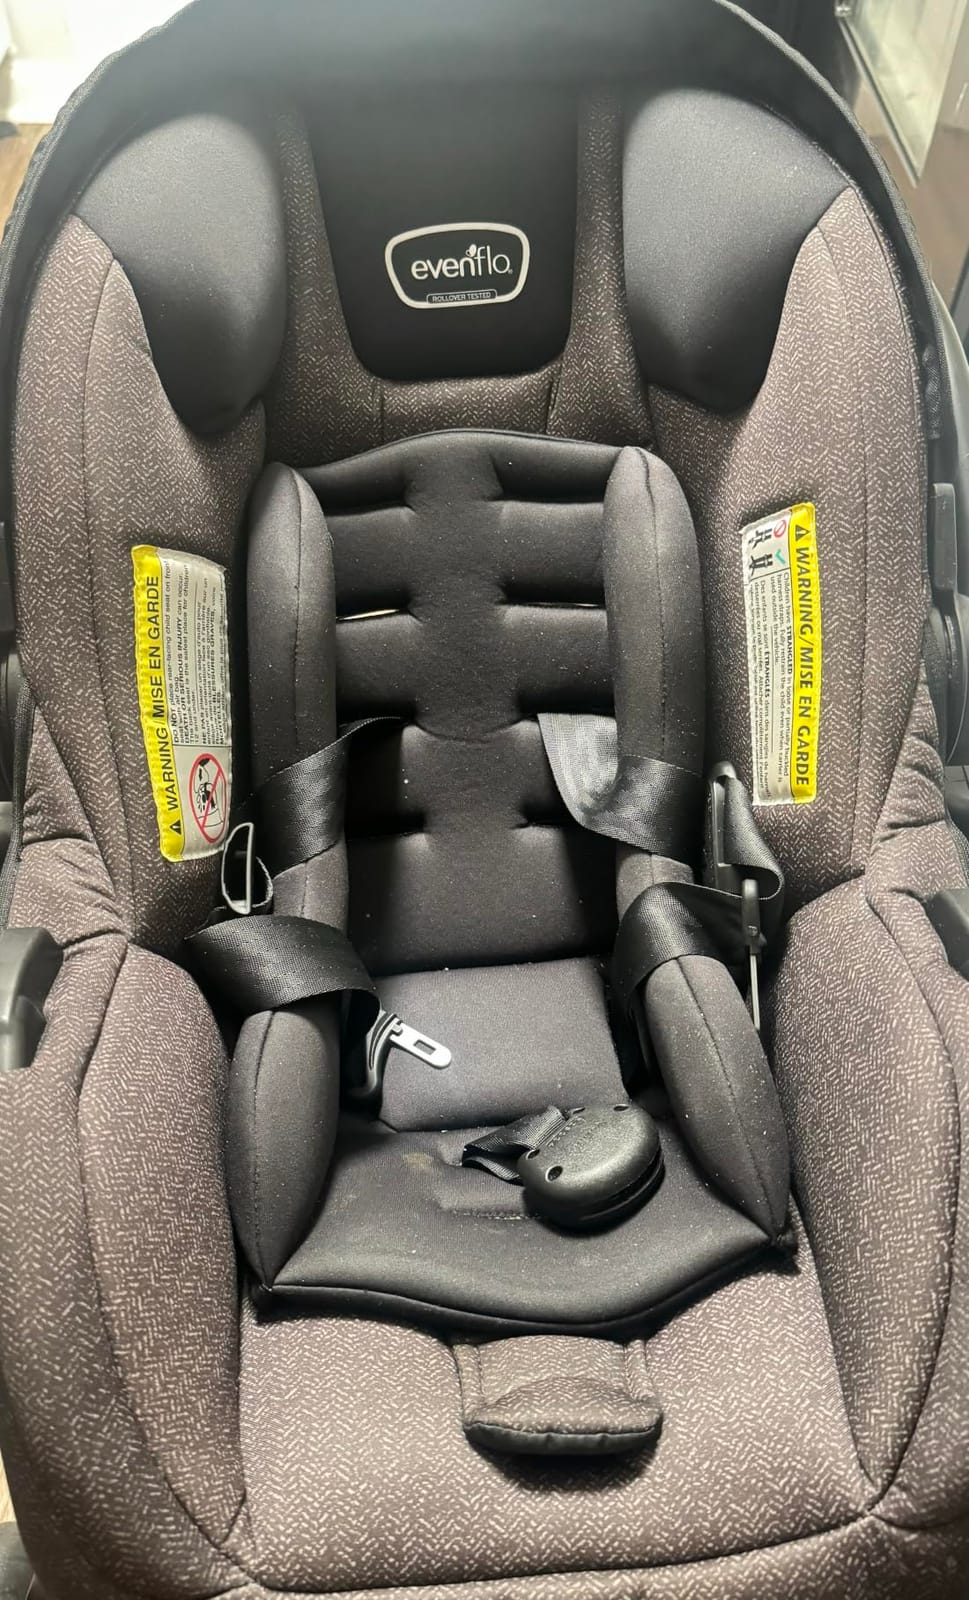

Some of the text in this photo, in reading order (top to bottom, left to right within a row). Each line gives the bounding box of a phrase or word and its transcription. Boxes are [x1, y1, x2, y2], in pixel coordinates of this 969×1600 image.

[432, 291, 491, 303] ROLLOVER TESTED
[166, 582, 170, 592] on
[146, 577, 160, 640] GARDE
[148, 646, 160, 669] EN
[795, 547, 814, 785] WARNING/MISE EN GARDE
[181, 697, 186, 710] OR
[173, 730, 179, 742] DO
